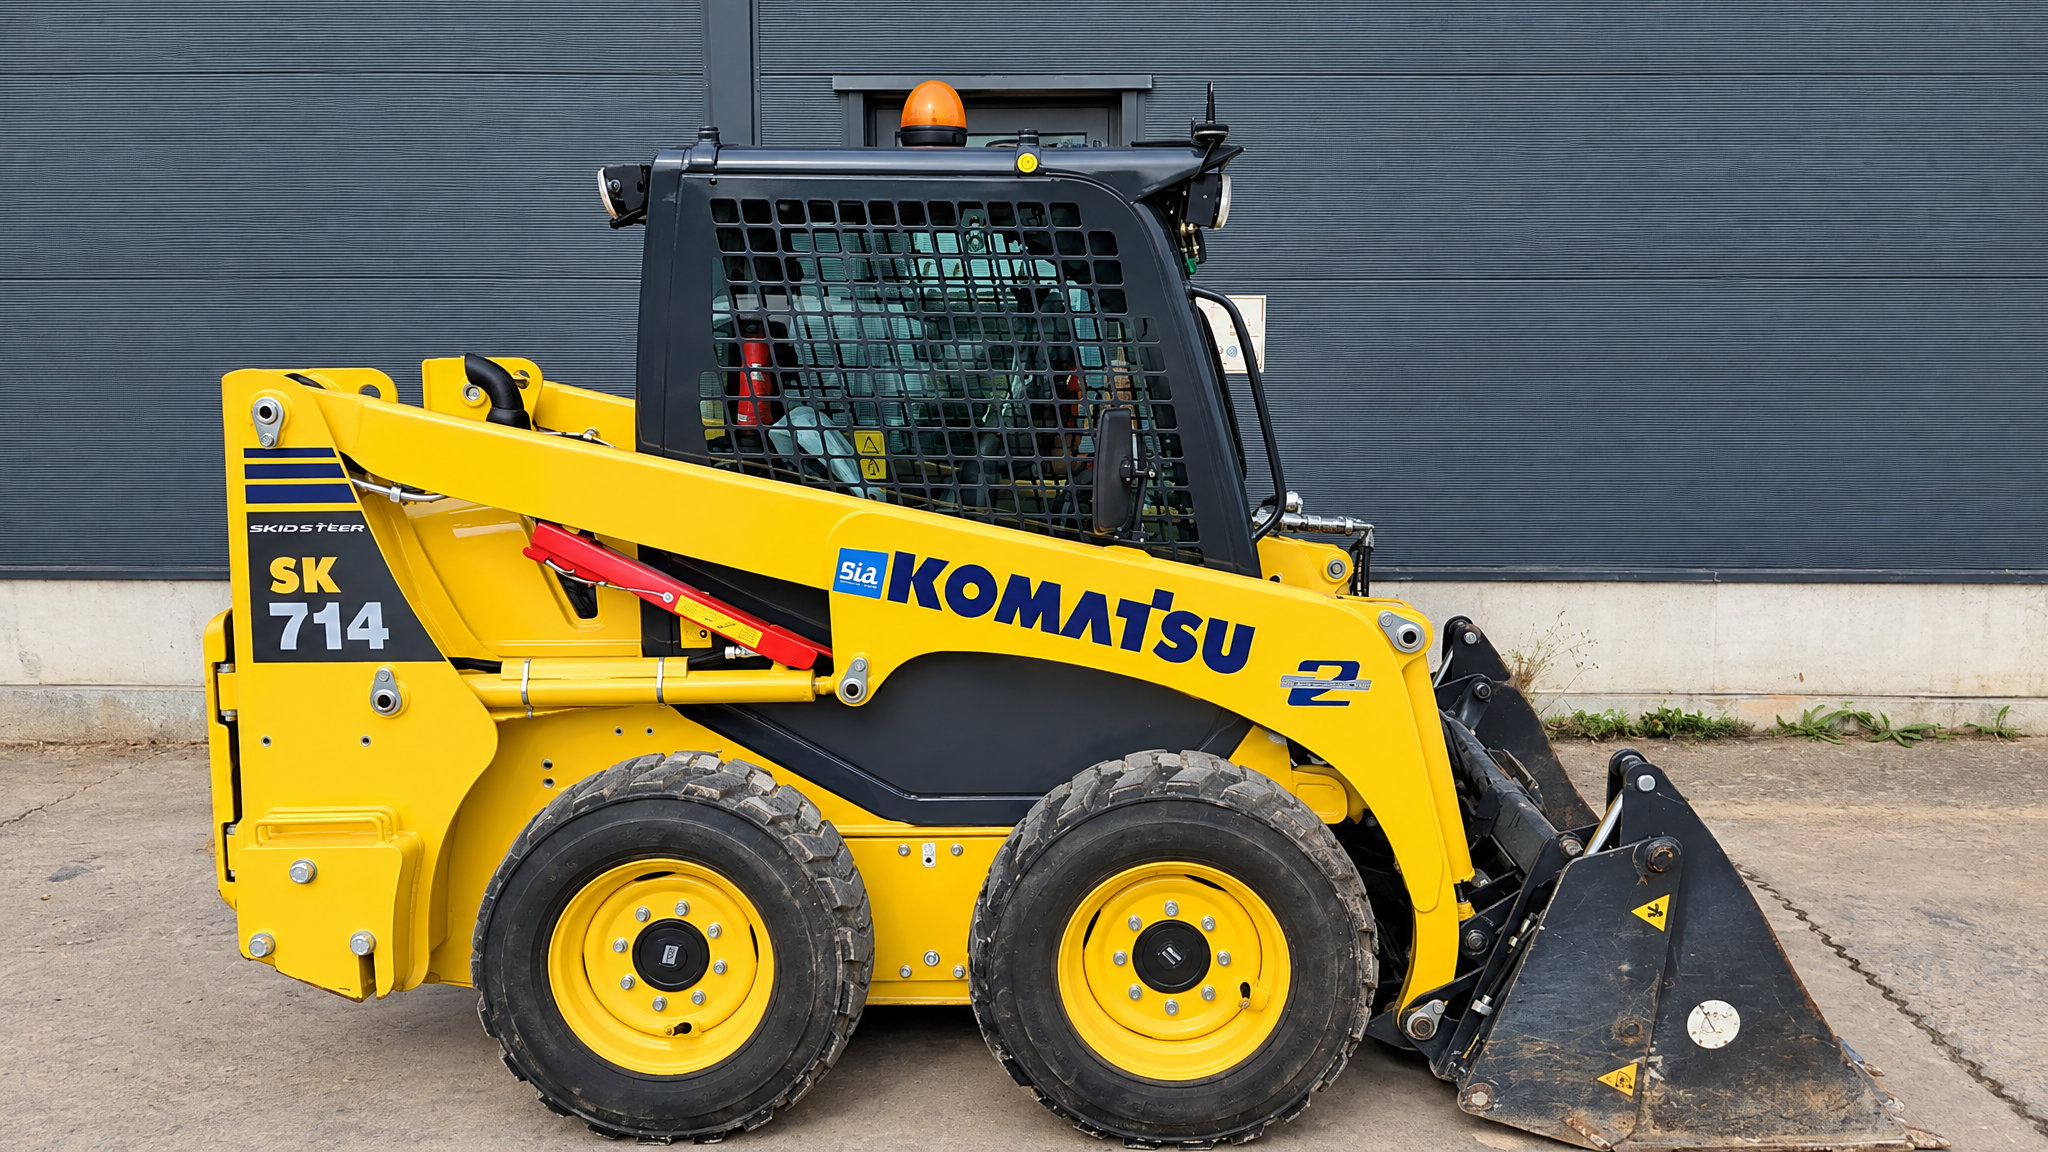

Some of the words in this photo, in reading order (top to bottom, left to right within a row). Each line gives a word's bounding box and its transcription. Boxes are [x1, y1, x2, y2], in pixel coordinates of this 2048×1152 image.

[269, 556, 342, 594] SK
[839, 561, 878, 585] Sia
[268, 602, 390, 650] 714
[887, 550, 1255, 674] KOMATSU
